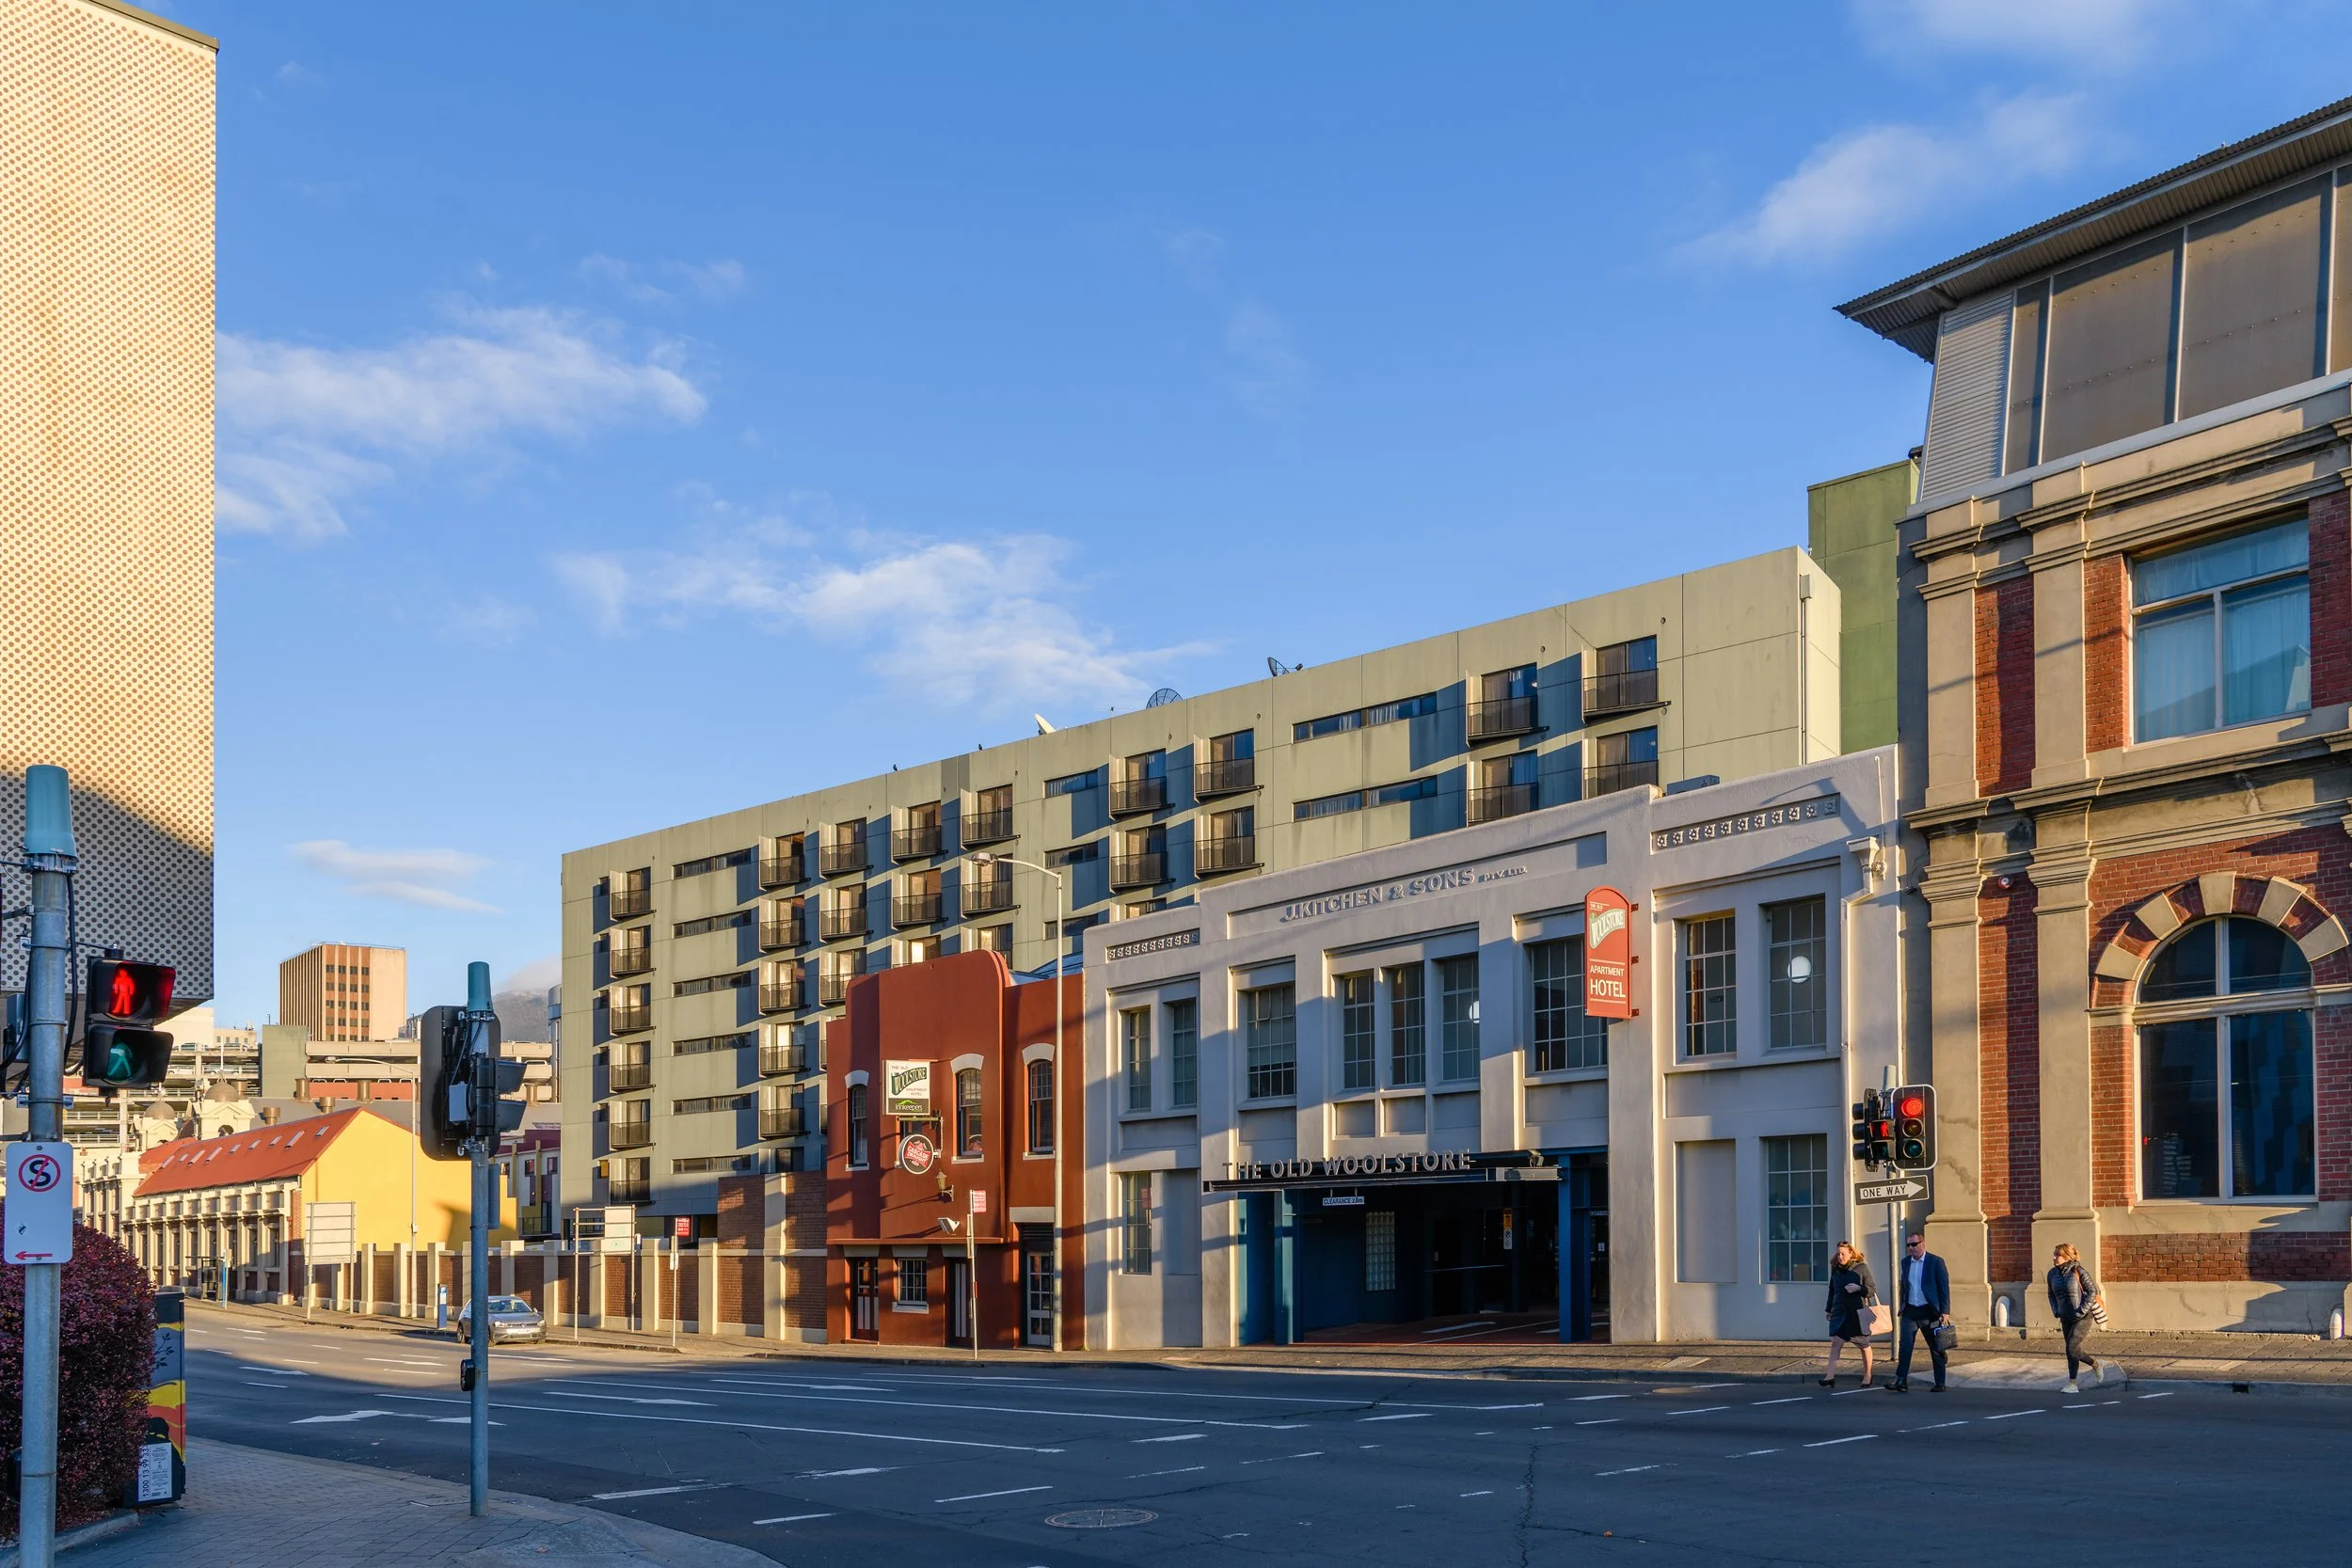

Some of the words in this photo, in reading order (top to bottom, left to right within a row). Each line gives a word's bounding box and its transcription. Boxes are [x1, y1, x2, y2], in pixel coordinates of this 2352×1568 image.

[1392, 883, 1406, 899] &
[1413, 867, 1475, 895] SONS
[1591, 911, 1624, 946] WOOLSTORE
[1590, 964, 1625, 977] APARTMENT
[1590, 978, 1626, 998] HOTEL
[894, 1068, 927, 1095] WOOLSTORE
[1222, 1161, 1262, 1180] THE
[1270, 1158, 1313, 1179] OLD
[1322, 1148, 1470, 1176] WOOLSTORE
[1863, 1187, 1883, 1198] ONE
[1886, 1184, 1906, 1196] WAY
[143, 1469, 150, 1478] 13
